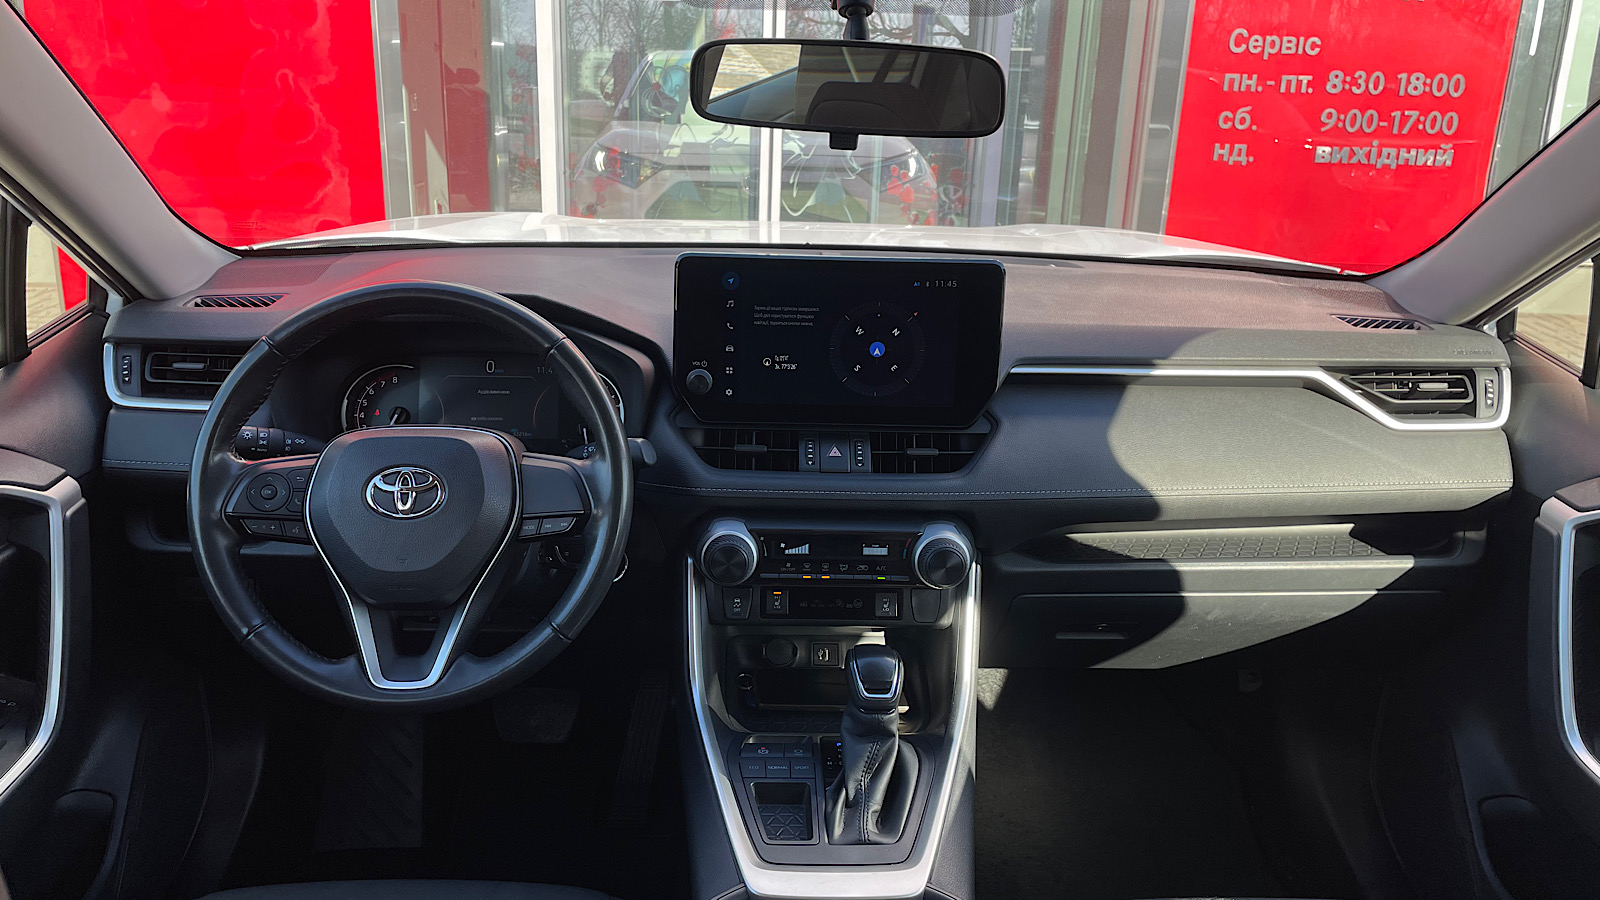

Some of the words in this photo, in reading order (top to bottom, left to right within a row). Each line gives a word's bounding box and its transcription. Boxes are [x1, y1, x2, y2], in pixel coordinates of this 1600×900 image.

[1320, 108, 1459, 136] 9:00-17:00
[1314, 140, 1455, 170] вихідний
[891, 327, 901, 337] N
[486, 360, 495, 374] 0
[536, 366, 553, 374] 11:4
[380, 380, 386, 388] 7
[392, 376, 398, 384] 8
[362, 399, 368, 407] 5
[359, 411, 365, 419] 4
